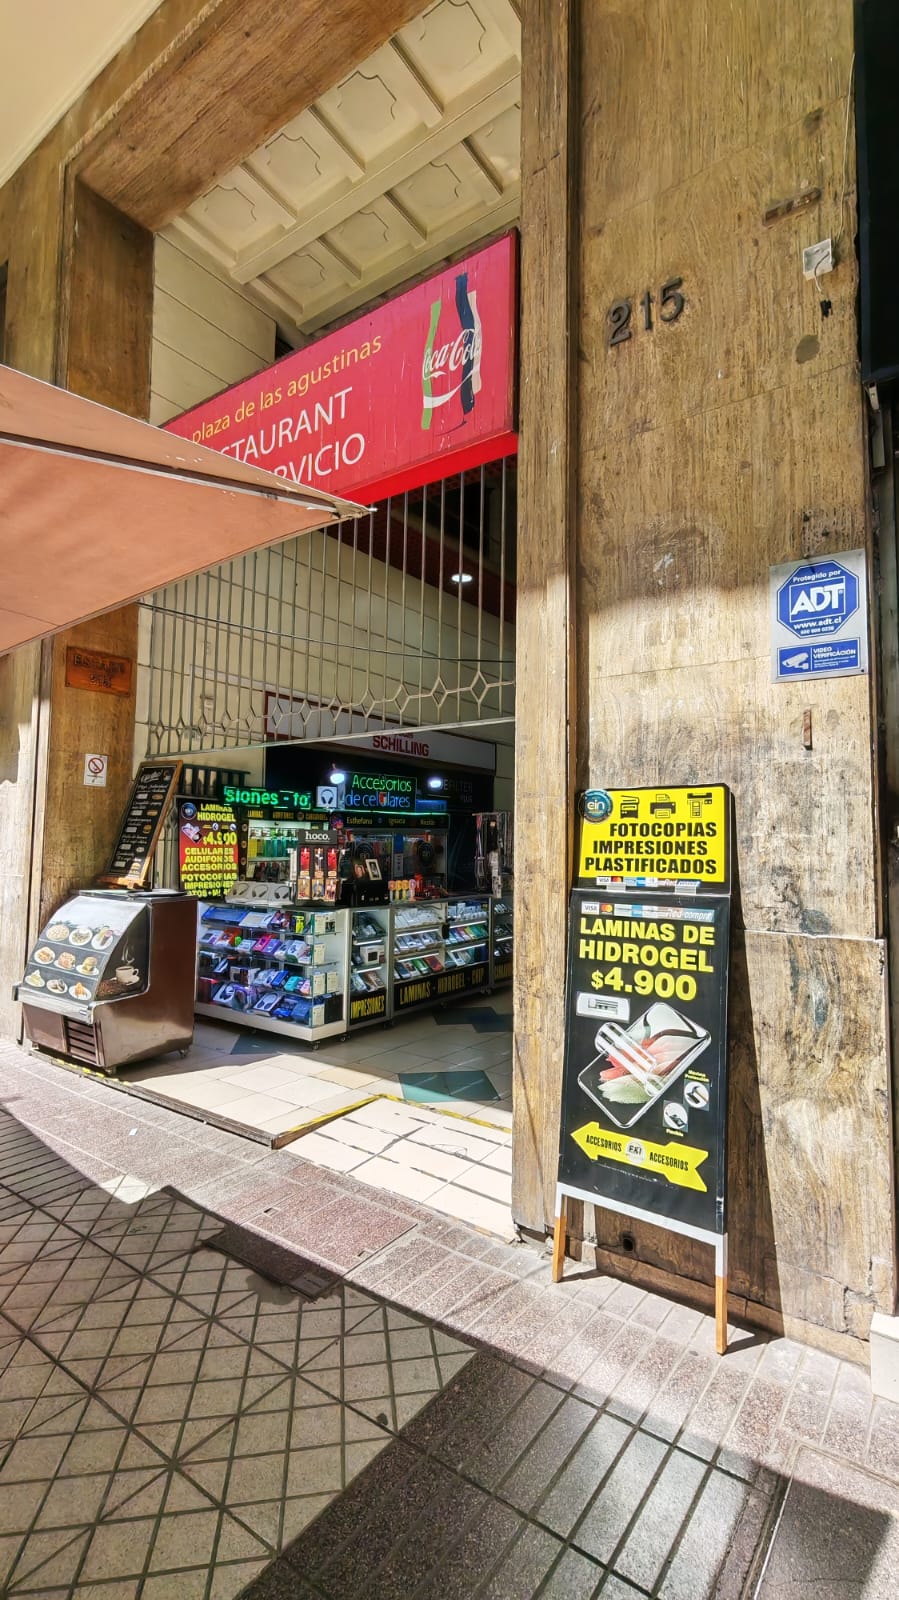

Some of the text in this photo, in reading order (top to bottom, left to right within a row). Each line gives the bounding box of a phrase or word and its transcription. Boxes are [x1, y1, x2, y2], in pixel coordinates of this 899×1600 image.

[606, 277, 684, 347] 215
[192, 335, 382, 444] plaza de las agustinas
[267, 433, 365, 483] RVICIO
[793, 569, 841, 583] Protegido por
[791, 583, 844, 615] ADT
[794, 616, 841, 630] www.adt.cl
[373, 735, 429, 756] SCHILLING
[352, 774, 412, 792] Accesorios
[345, 792, 361, 806] de
[197, 812, 236, 822] HIDROGEL
[610, 822, 717, 837] FOTOCOPIAS
[593, 841, 708, 855] IMPRESIONES
[181, 863, 237, 871] ACCESORIOS
[585, 857, 717, 874] PLASTIFICADOS
[580, 917, 715, 946] LAMINAS DE
[579, 939, 714, 973] HIDROGEL
[400, 981, 431, 1005] LAMINAS
[591, 966, 697, 1001] $4.900
[586, 1134, 622, 1152] ACCESORIOS
[650, 1152, 689, 1172] ACCESORIOS
